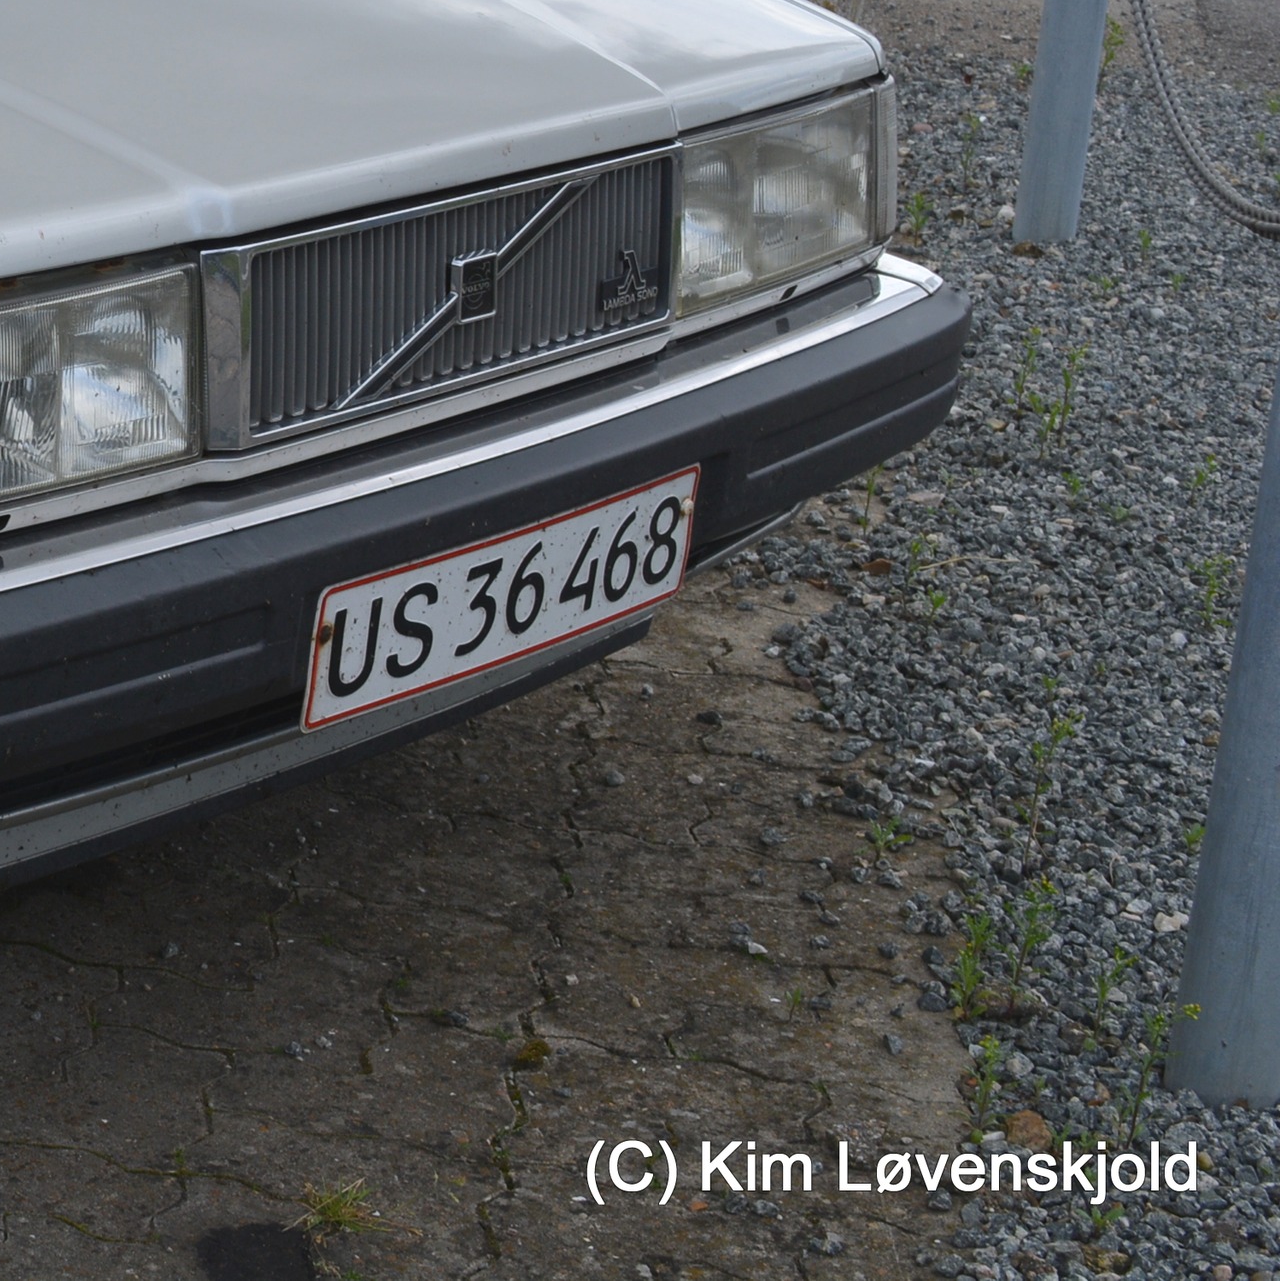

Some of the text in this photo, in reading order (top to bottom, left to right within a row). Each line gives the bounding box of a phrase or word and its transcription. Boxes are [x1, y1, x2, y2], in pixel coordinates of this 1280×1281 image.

[461, 281, 490, 295] VOLVO
[603, 286, 658, 311] LAMBDA SOND
[327, 495, 682, 698] US 36 468
